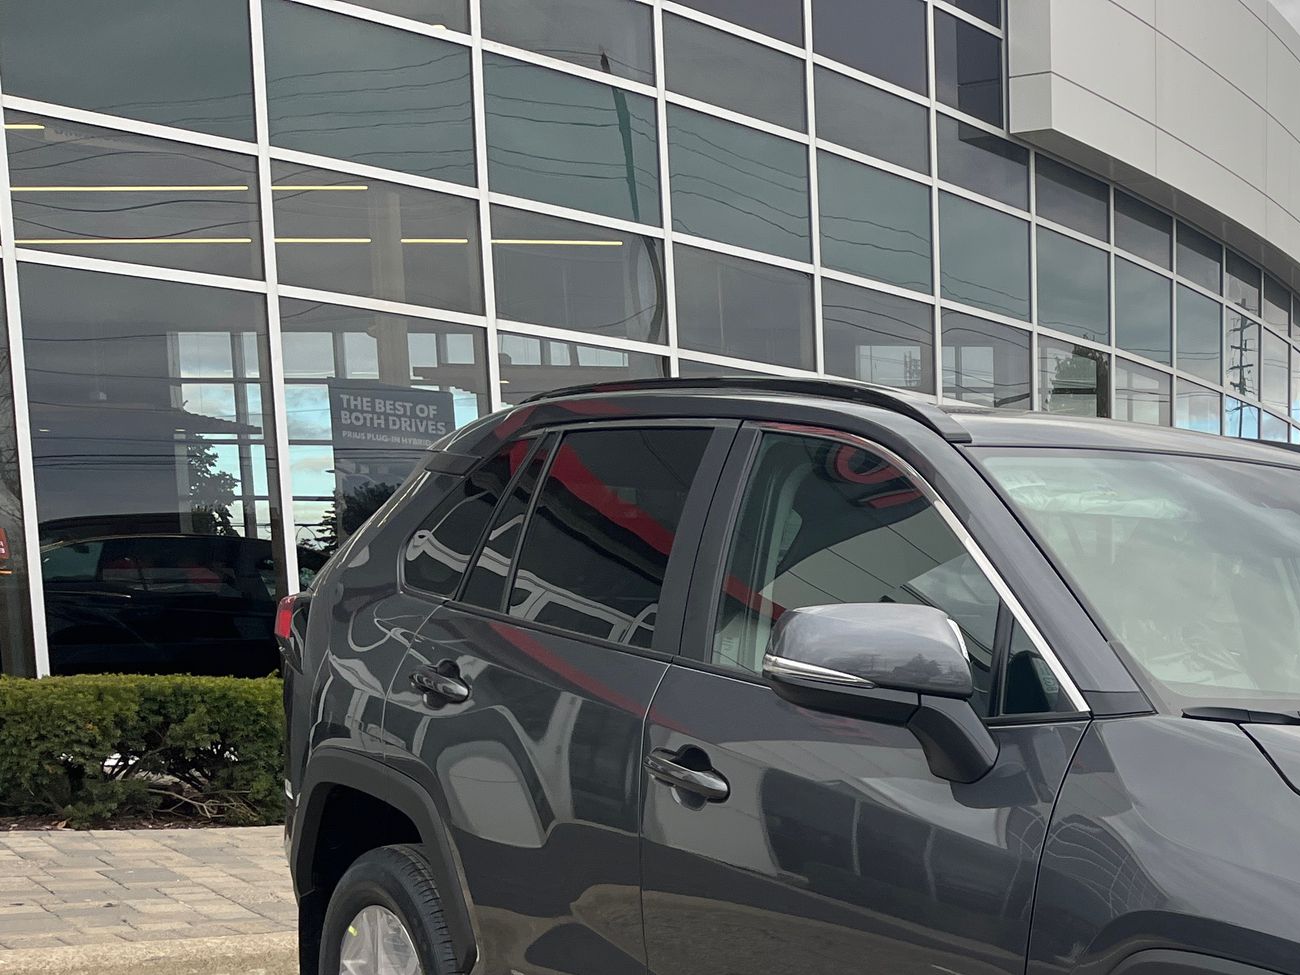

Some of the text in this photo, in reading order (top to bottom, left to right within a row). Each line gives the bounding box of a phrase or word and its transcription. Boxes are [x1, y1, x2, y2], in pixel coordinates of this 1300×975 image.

[340, 394, 438, 418] THE BEST OF
[340, 411, 447, 435] BOTH DRIVES
[342, 430, 366, 439] PRIUS
